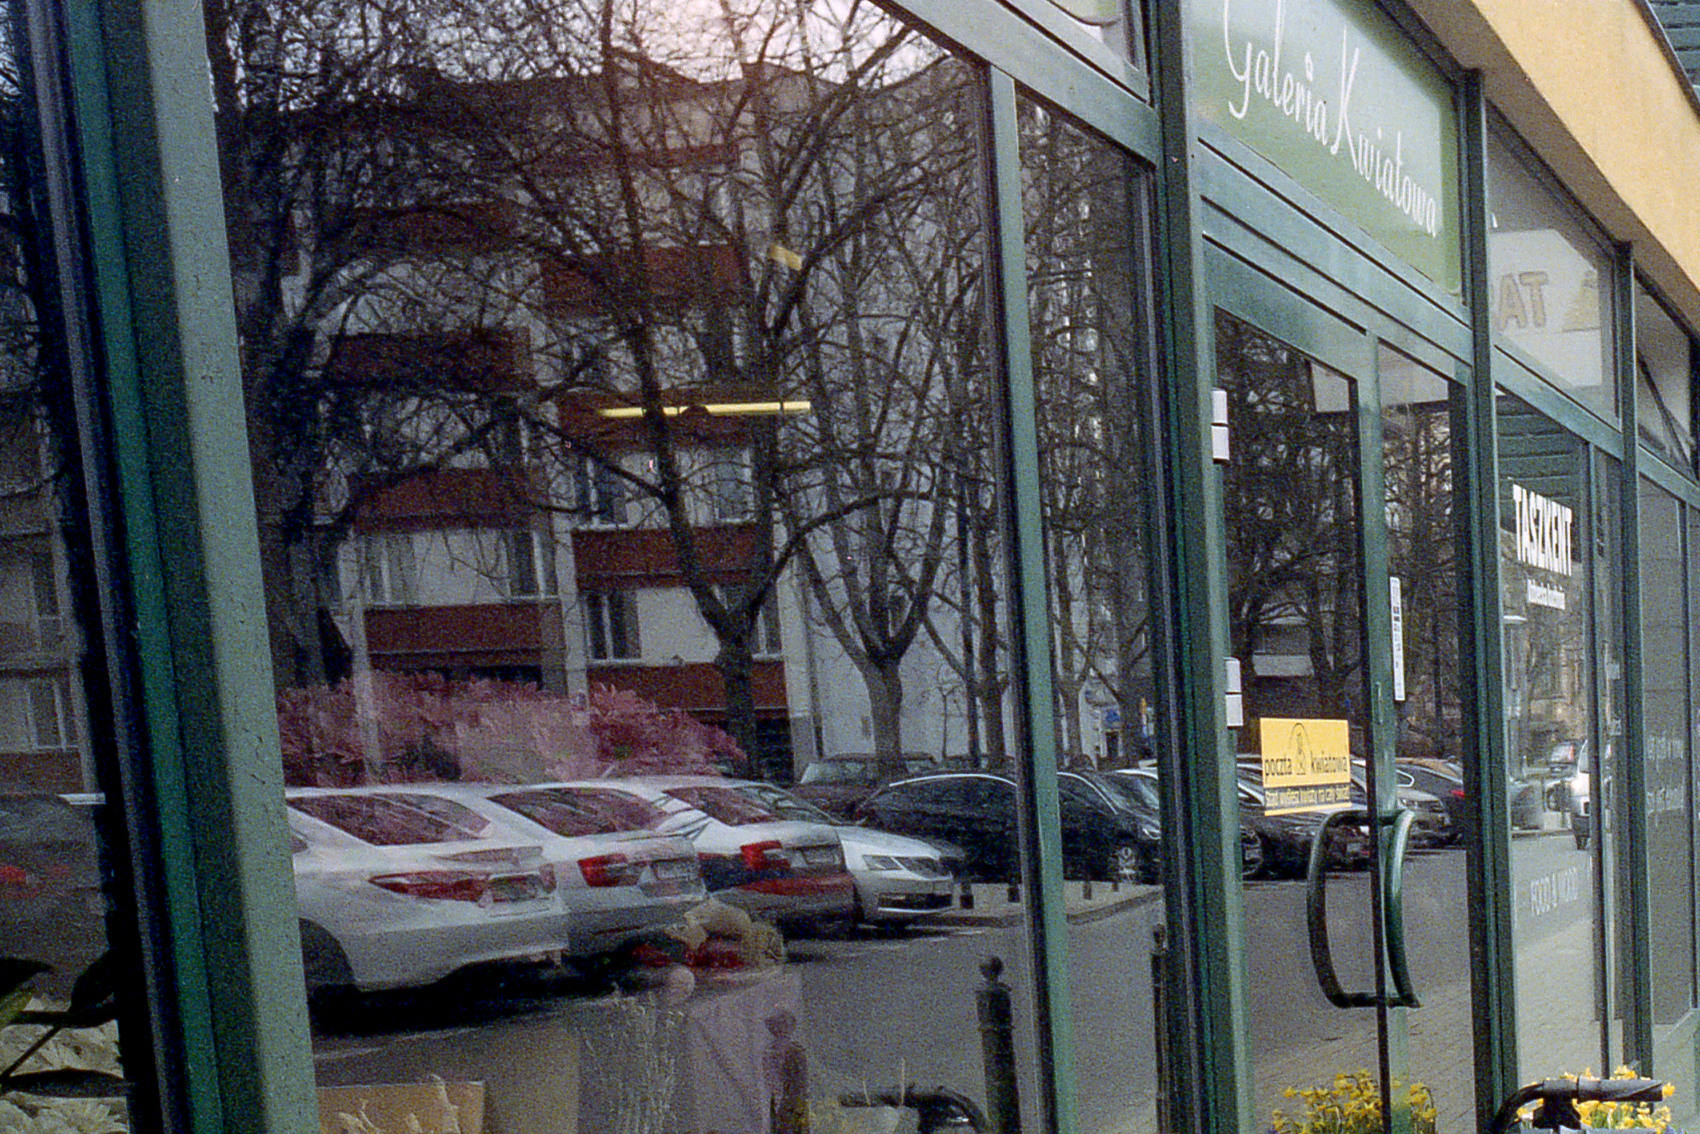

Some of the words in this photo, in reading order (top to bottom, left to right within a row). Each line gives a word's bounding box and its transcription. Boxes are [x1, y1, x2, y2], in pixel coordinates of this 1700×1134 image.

[1223, 0, 1328, 146] Galeria
[1330, 24, 1437, 238] Kwiatowa
[1512, 483, 1572, 577] TASZKENT
[1264, 756, 1292, 783] poczta
